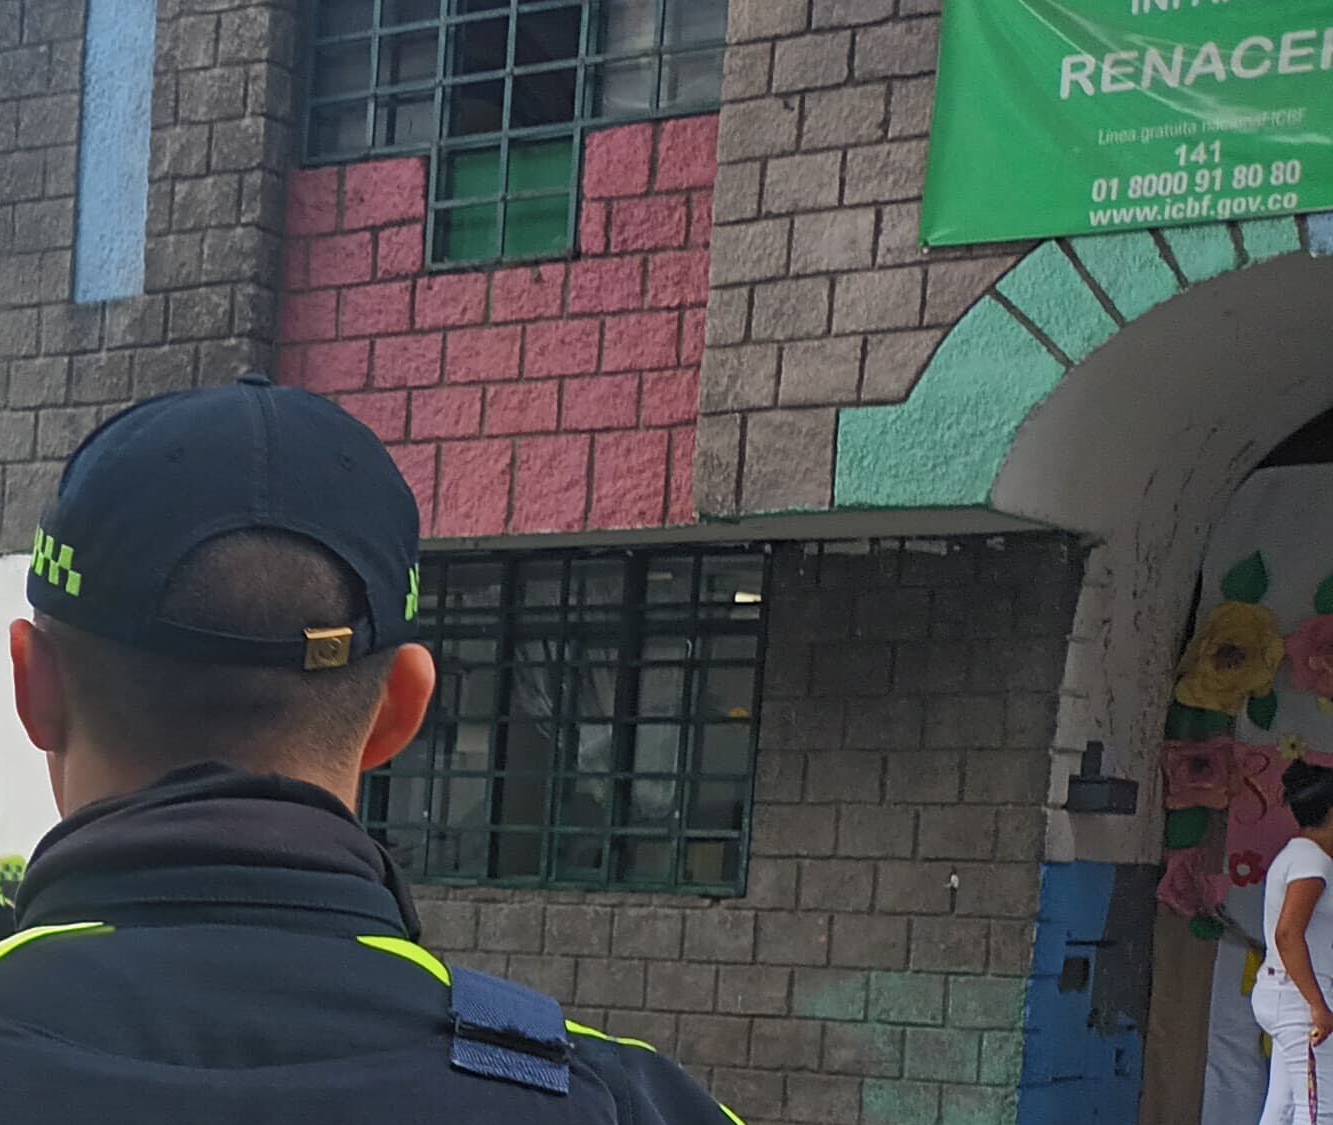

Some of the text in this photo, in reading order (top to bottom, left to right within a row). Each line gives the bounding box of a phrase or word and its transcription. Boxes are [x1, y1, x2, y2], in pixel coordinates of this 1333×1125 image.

[1174, 139, 1222, 167] 141
[1091, 159, 1302, 202] 01 8000 91 80 80
[1088, 191, 1299, 227] www.icbf.gov.co
